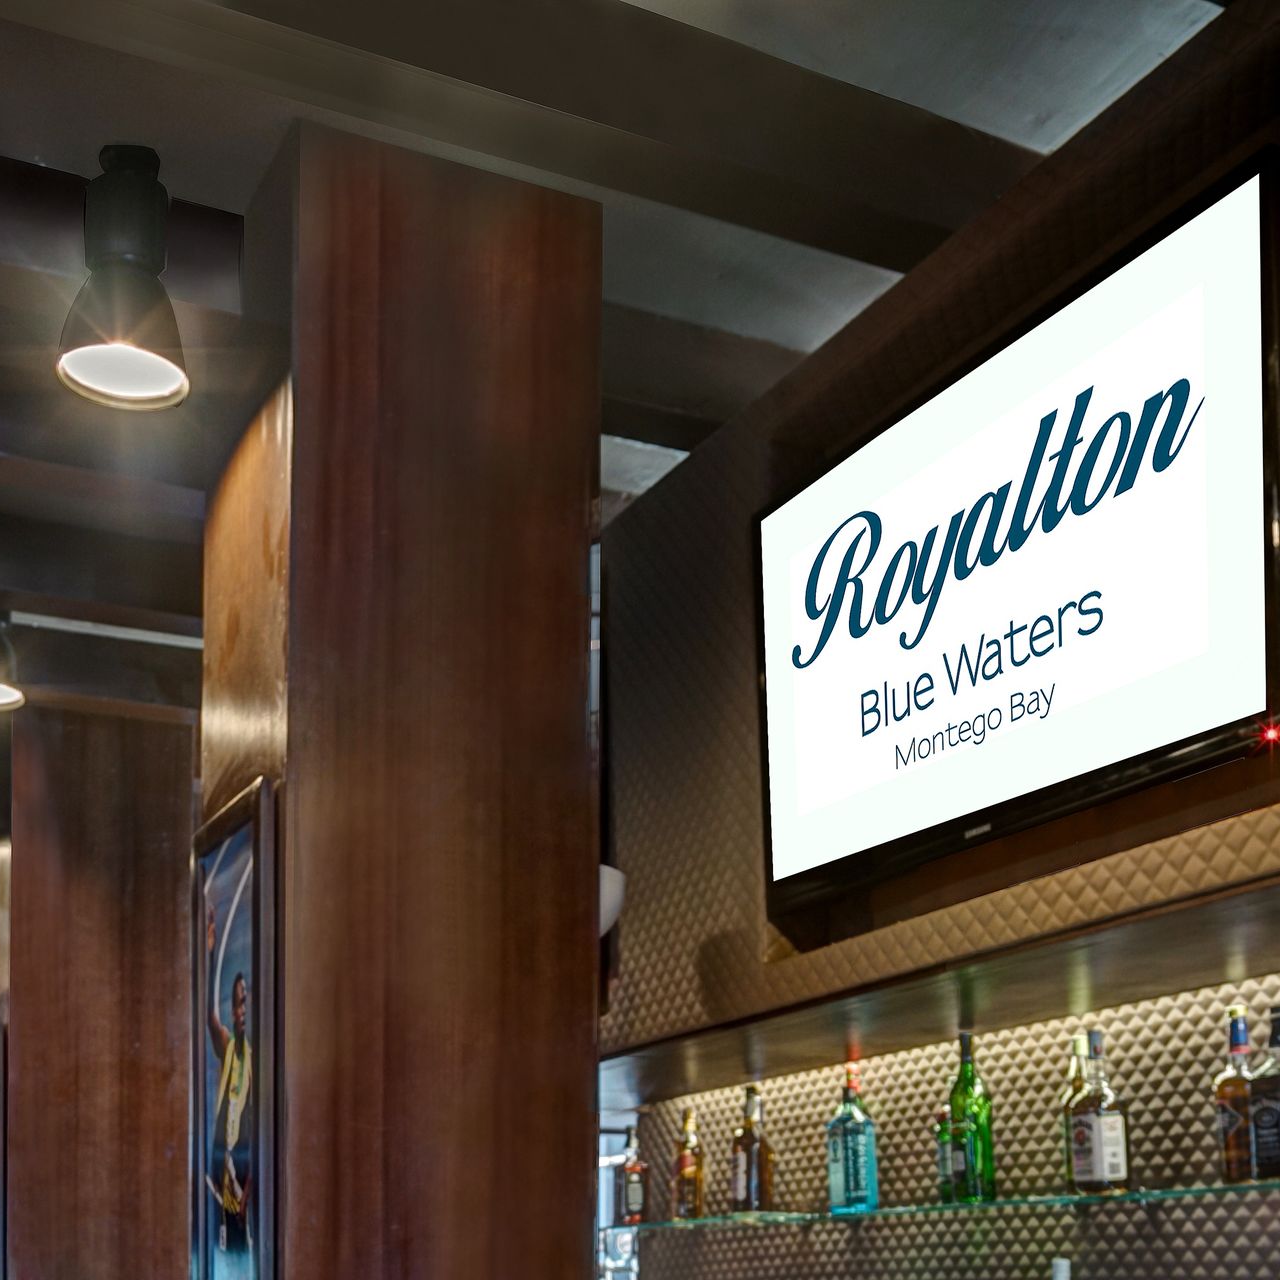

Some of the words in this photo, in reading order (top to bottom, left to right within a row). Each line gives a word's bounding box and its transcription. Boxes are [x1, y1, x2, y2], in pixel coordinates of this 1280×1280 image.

[792, 378, 1205, 669] Royalton
[861, 673, 934, 737] Blue
[943, 591, 1103, 695] Waters
[896, 708, 1002, 769] Montego
[1011, 684, 1055, 722] Bay
